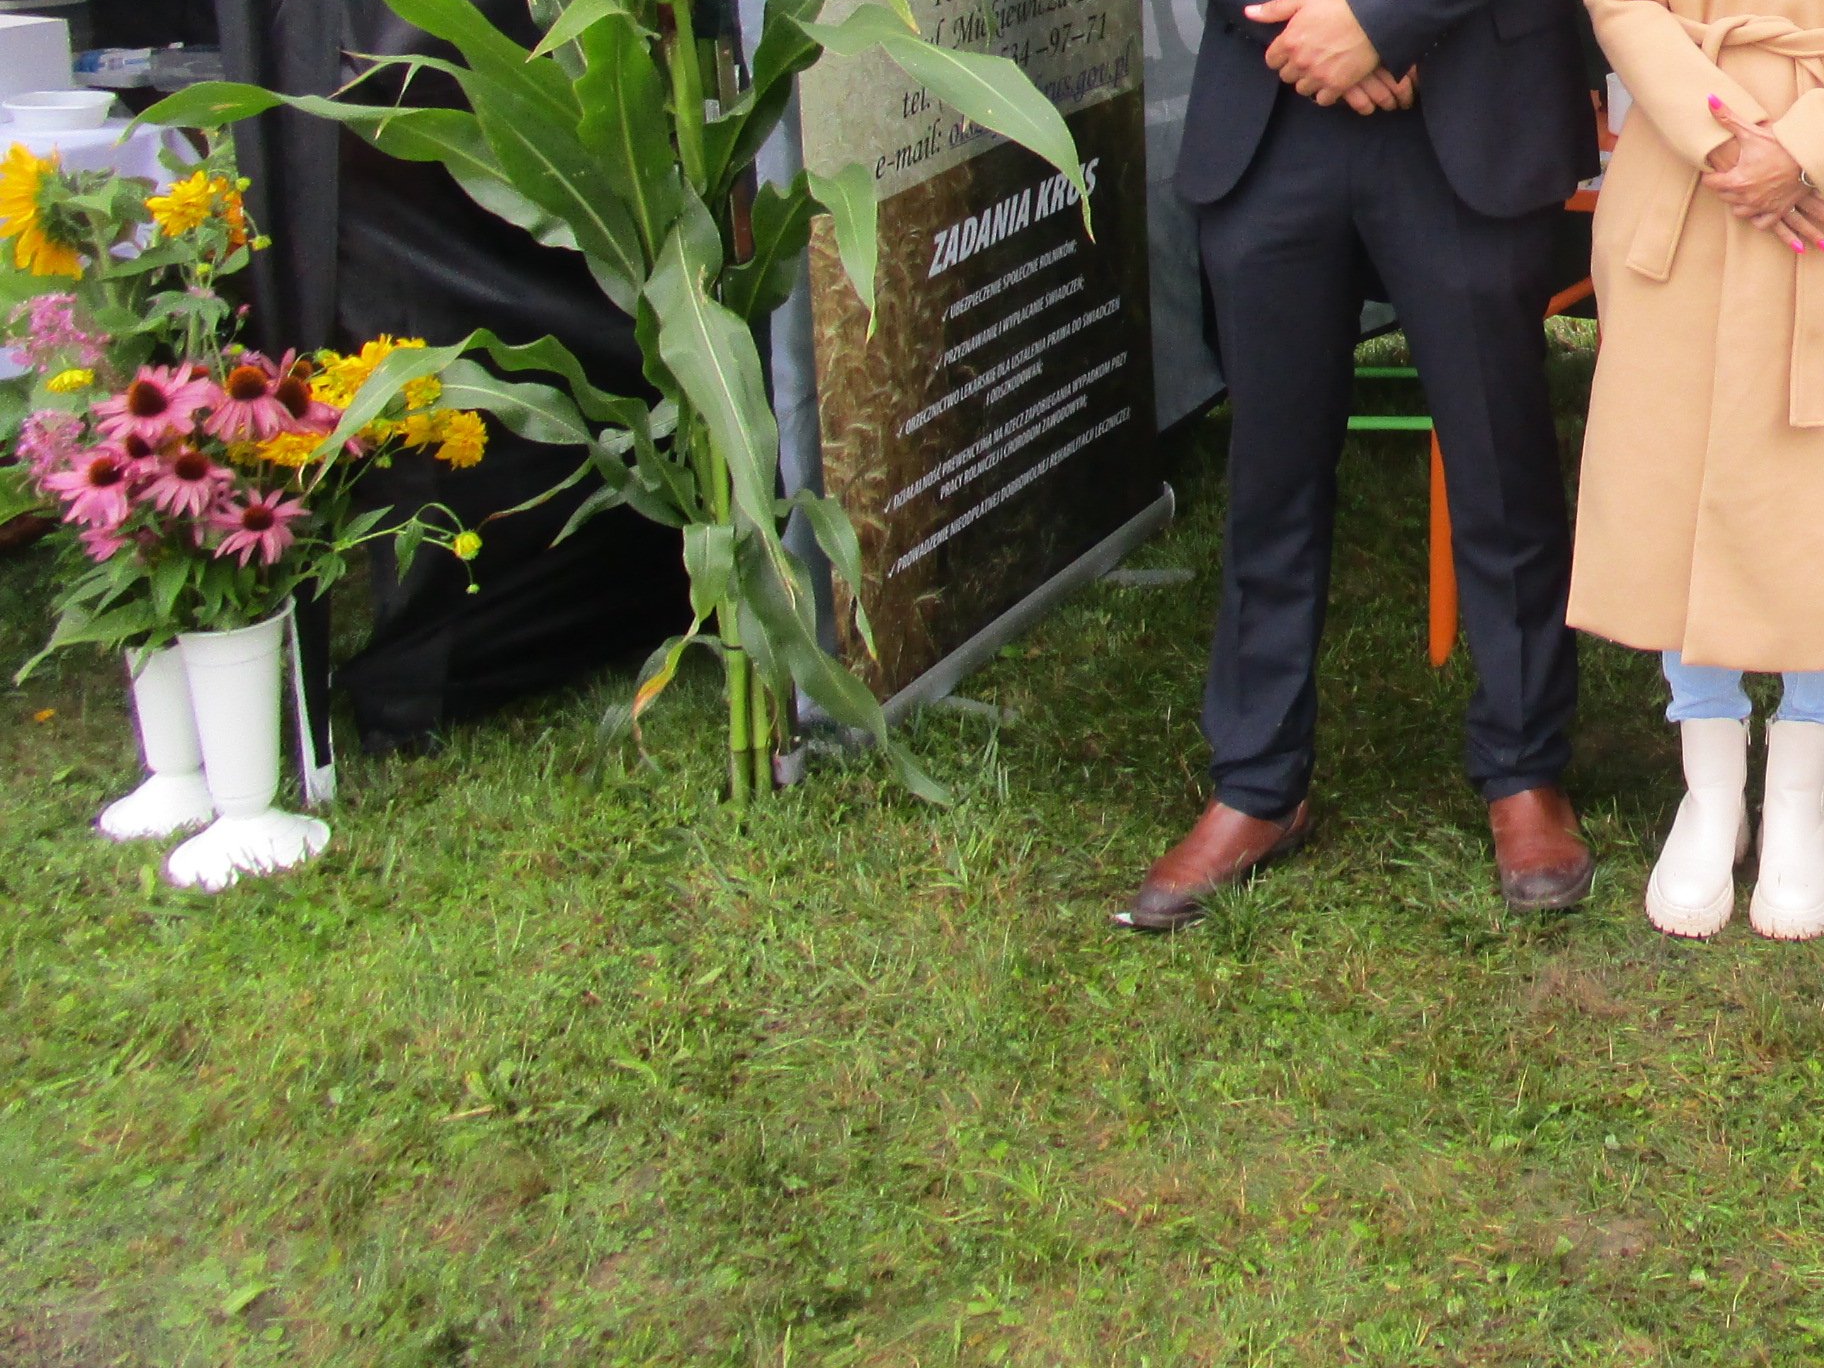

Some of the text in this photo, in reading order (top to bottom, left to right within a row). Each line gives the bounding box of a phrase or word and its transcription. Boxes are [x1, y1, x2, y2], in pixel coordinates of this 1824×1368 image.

[903, 87, 930, 119] tel.
[875, 118, 941, 179] e-mail:
[928, 188, 1031, 279] ZADANIA
